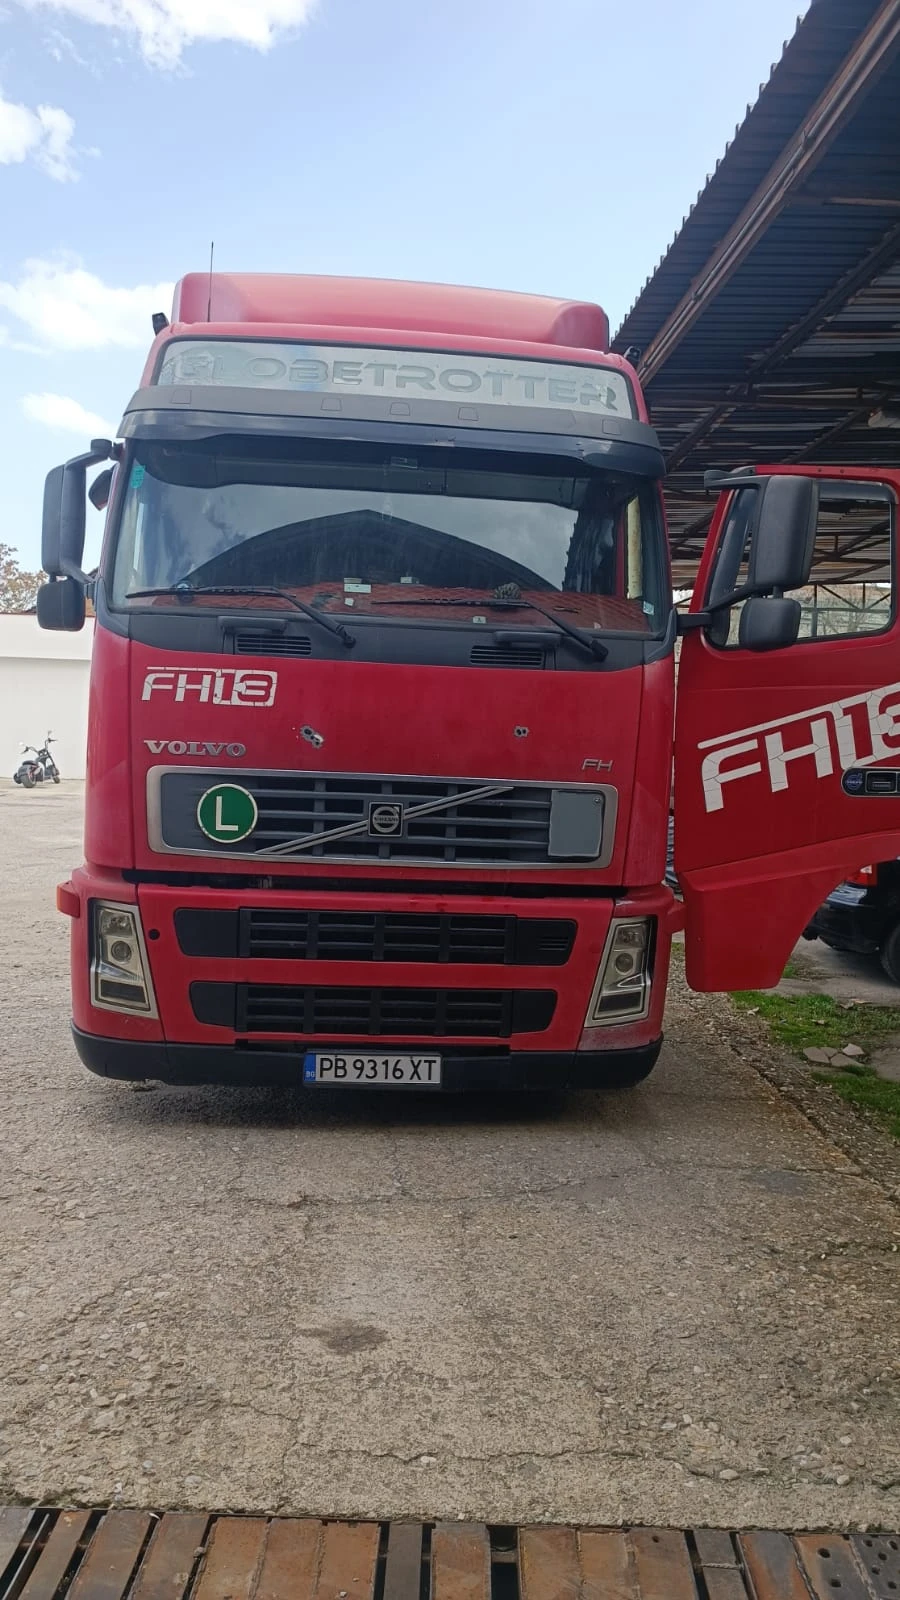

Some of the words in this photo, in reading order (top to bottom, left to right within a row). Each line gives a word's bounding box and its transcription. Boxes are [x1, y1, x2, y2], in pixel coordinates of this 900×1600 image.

[141, 666, 278, 707] FH13
[143, 739, 247, 757] VOLVO
[581, 758, 613, 771] FH
[215, 795, 239, 831] L
